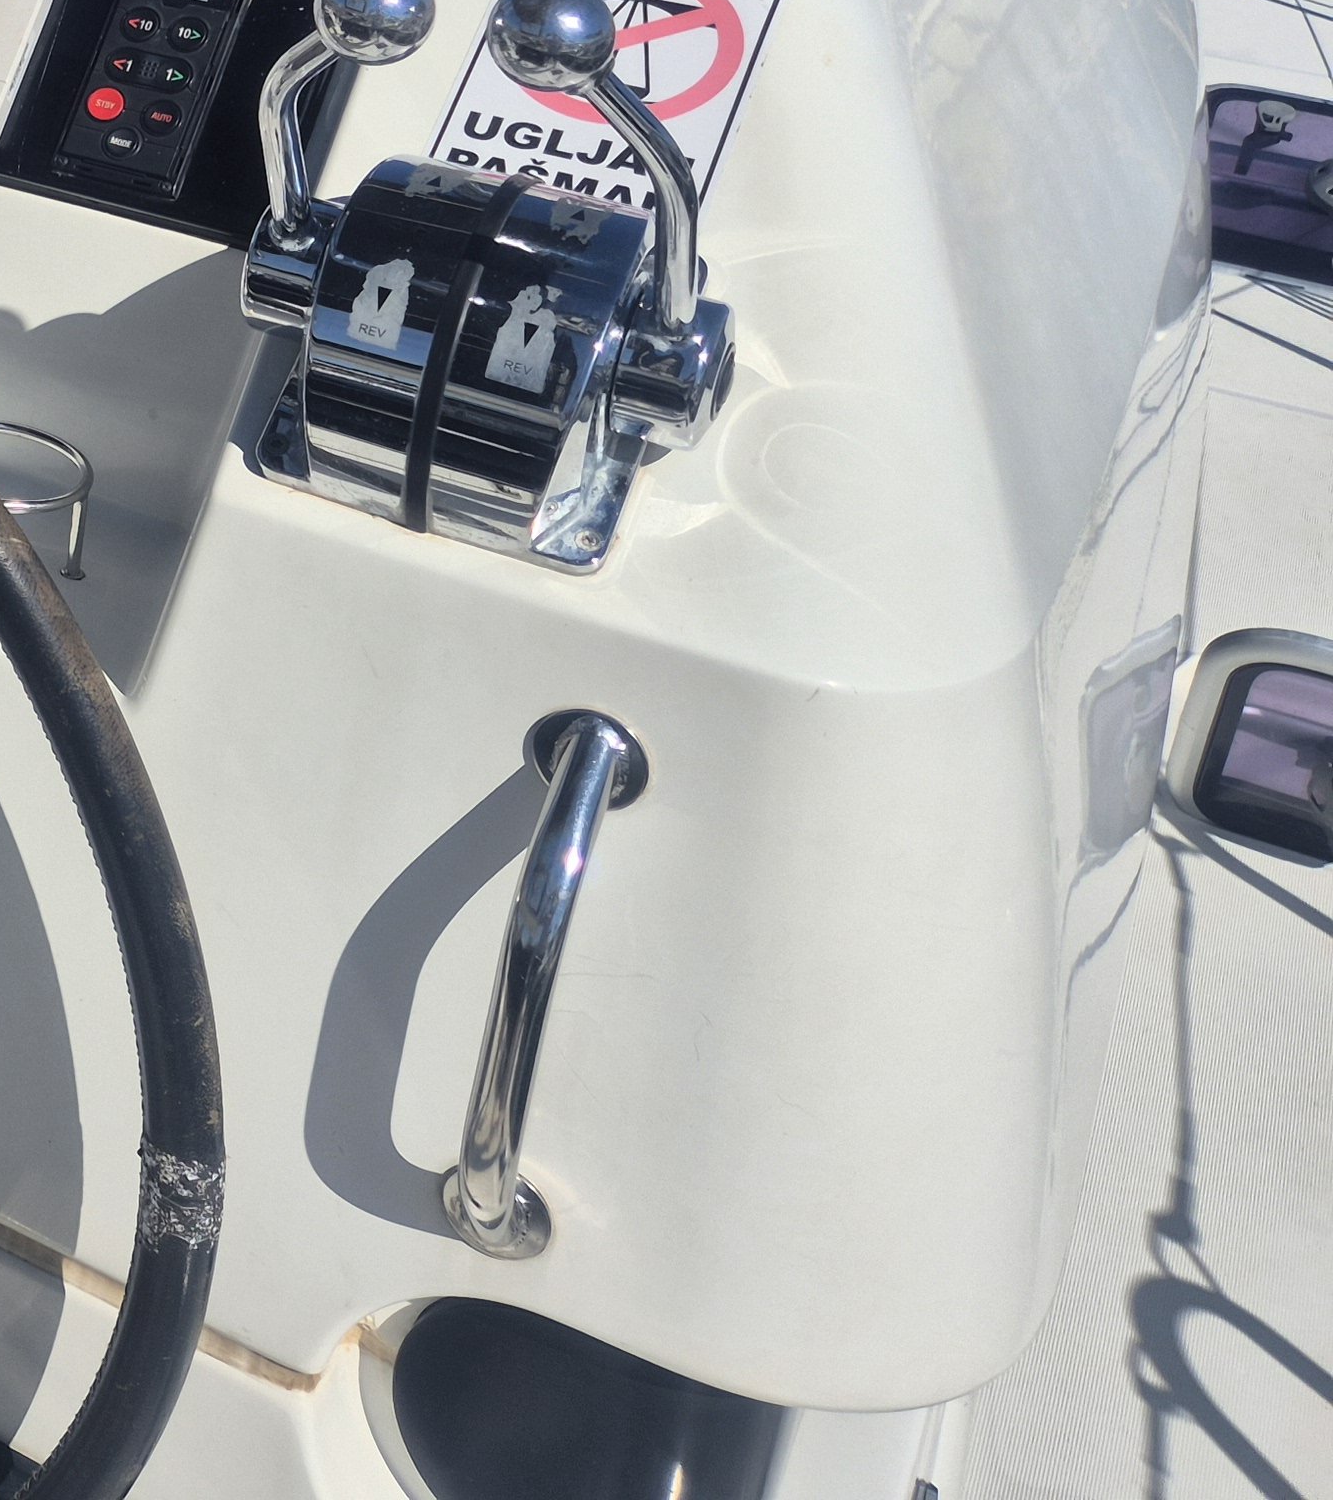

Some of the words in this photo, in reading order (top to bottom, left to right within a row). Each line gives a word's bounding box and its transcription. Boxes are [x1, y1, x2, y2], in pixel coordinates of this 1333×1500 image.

[150, 112, 173, 123] AUTO
[109, 136, 132, 148] MODE
[463, 111, 696, 176] UGLJA
[446, 147, 656, 211] PAŠMA
[358, 323, 387, 338] REV
[503, 359, 533, 376] REV
